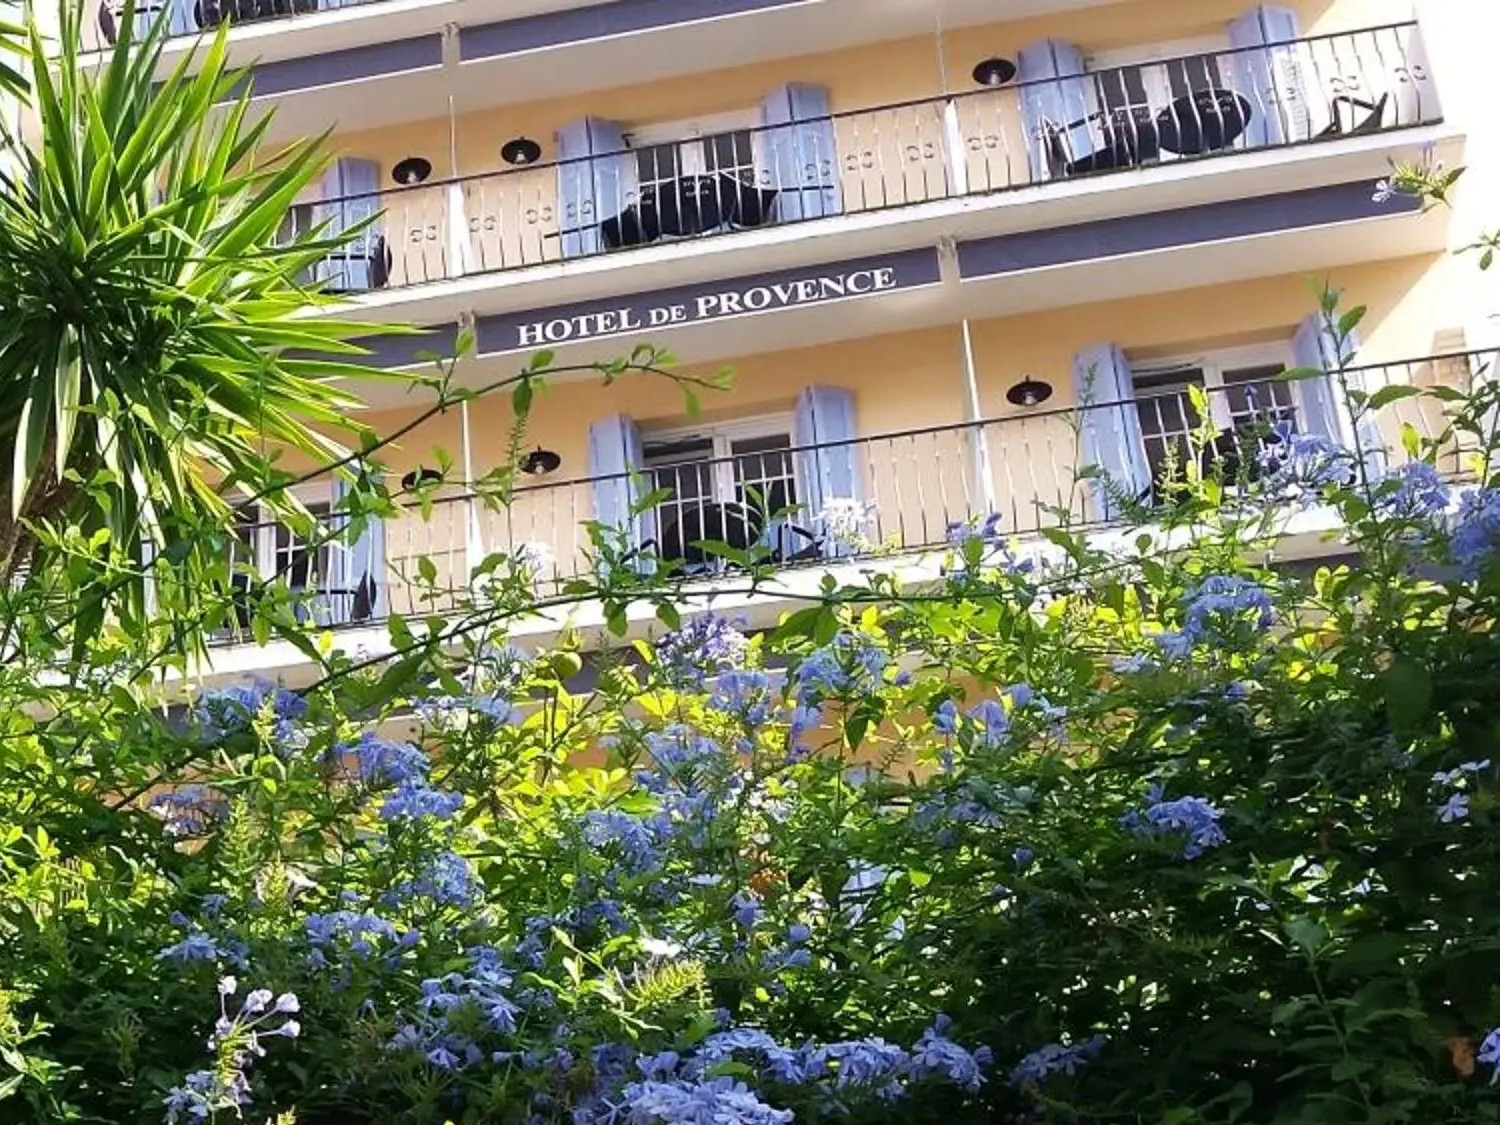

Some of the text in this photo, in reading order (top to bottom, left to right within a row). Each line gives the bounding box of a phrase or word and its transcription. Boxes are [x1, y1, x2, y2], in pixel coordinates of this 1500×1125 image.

[517, 266, 897, 347] HOTEL DE PROVENCE
